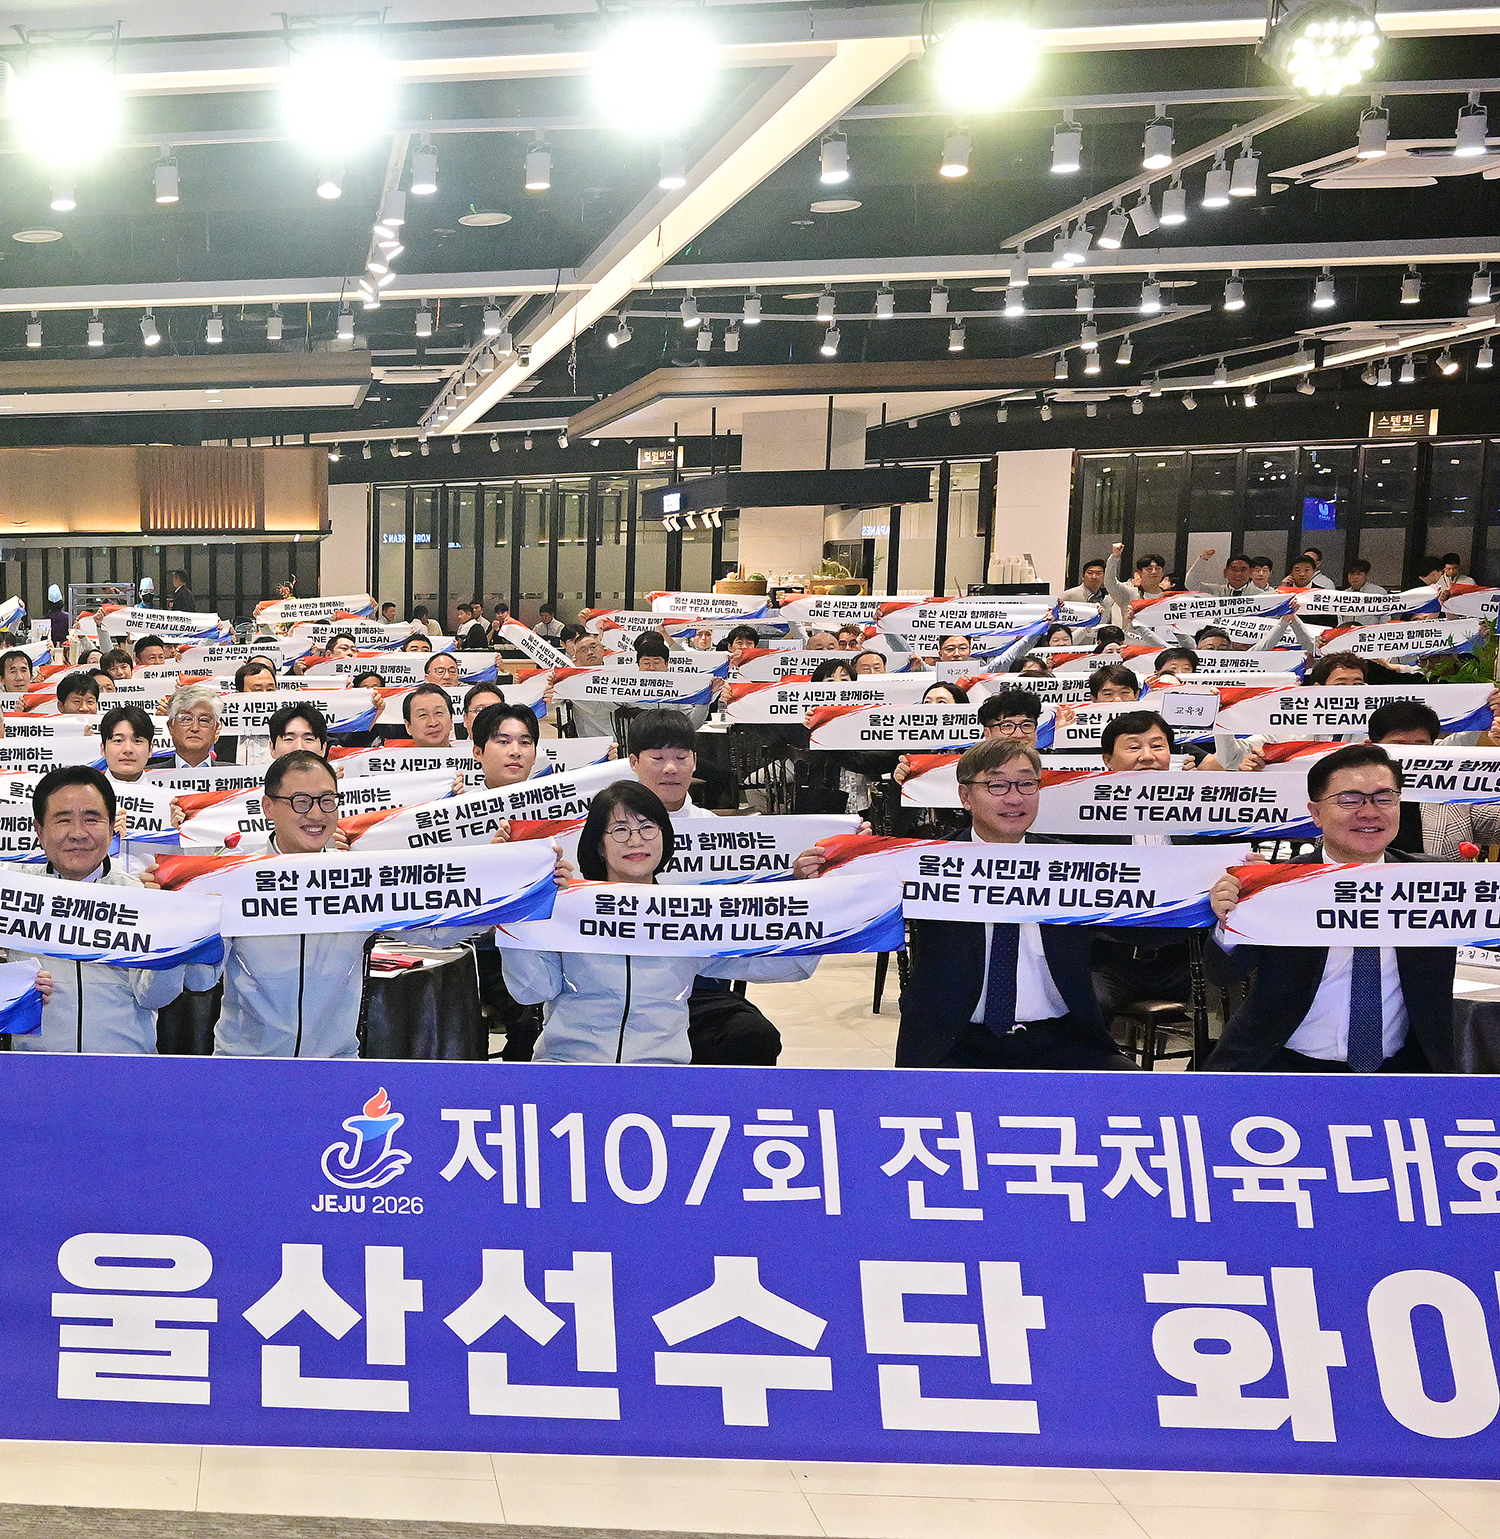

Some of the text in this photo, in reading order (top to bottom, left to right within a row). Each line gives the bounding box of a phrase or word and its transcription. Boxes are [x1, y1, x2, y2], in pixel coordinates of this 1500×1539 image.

[1378, 414, 1425, 426] 스텐퍼드
[1169, 597, 1255, 611] 울산 시민과 함께하는
[1313, 594, 1401, 604] 울산 시민과 함께하는
[919, 609, 1007, 619] 울산 시민과 함께하는
[1164, 605, 1261, 620] ONE TEAM ULSAN
[1306, 603, 1407, 613] ONE TEAM ULSAN
[126, 620, 197, 632] ONE TEAM ULSAN
[131, 611, 192, 624] 울산 시민과 함께하는
[912, 620, 1013, 629] ONE TEAM ULSAN
[592, 675, 674, 688] 울산 시민과 함께하는
[585, 686, 679, 697] ONE TEAM ULSAN
[1174, 706, 1204, 716] 교육청
[1280, 698, 1359, 710] 울산 시민과
[1270, 714, 1366, 725] ONE TEAM
[1094, 785, 1277, 802] 울산 시민과 함께하는
[416, 783, 578, 829] 울산 시민과 함께하는
[1079, 806, 1289, 823] ONE TEAM ULSAN
[408, 828, 452, 848] ONE
[698, 832, 776, 850] 함께하는
[710, 854, 790, 871] ULSAN
[919, 855, 1141, 883] 울산 시민과 함께하는
[256, 863, 466, 891] 울산 시민과 함께하는
[902, 881, 1156, 908] ONE TEAM ULSAN
[1334, 881, 1466, 902] 울산 시민과
[51, 896, 138, 926] 함께하는
[242, 888, 483, 917] ONE TEAM ULSAN
[595, 894, 809, 917] 울산 시민과 함께하는
[1316, 910, 1476, 929] ONE TEAM
[58, 924, 152, 953] ULSAN
[580, 919, 824, 941] ONE TEAM ULSAN
[439, 1104, 841, 1215] 제107회
[312, 1195, 423, 1214] JEJU 2026
[52, 1233, 1046, 1434] 울산선수단
